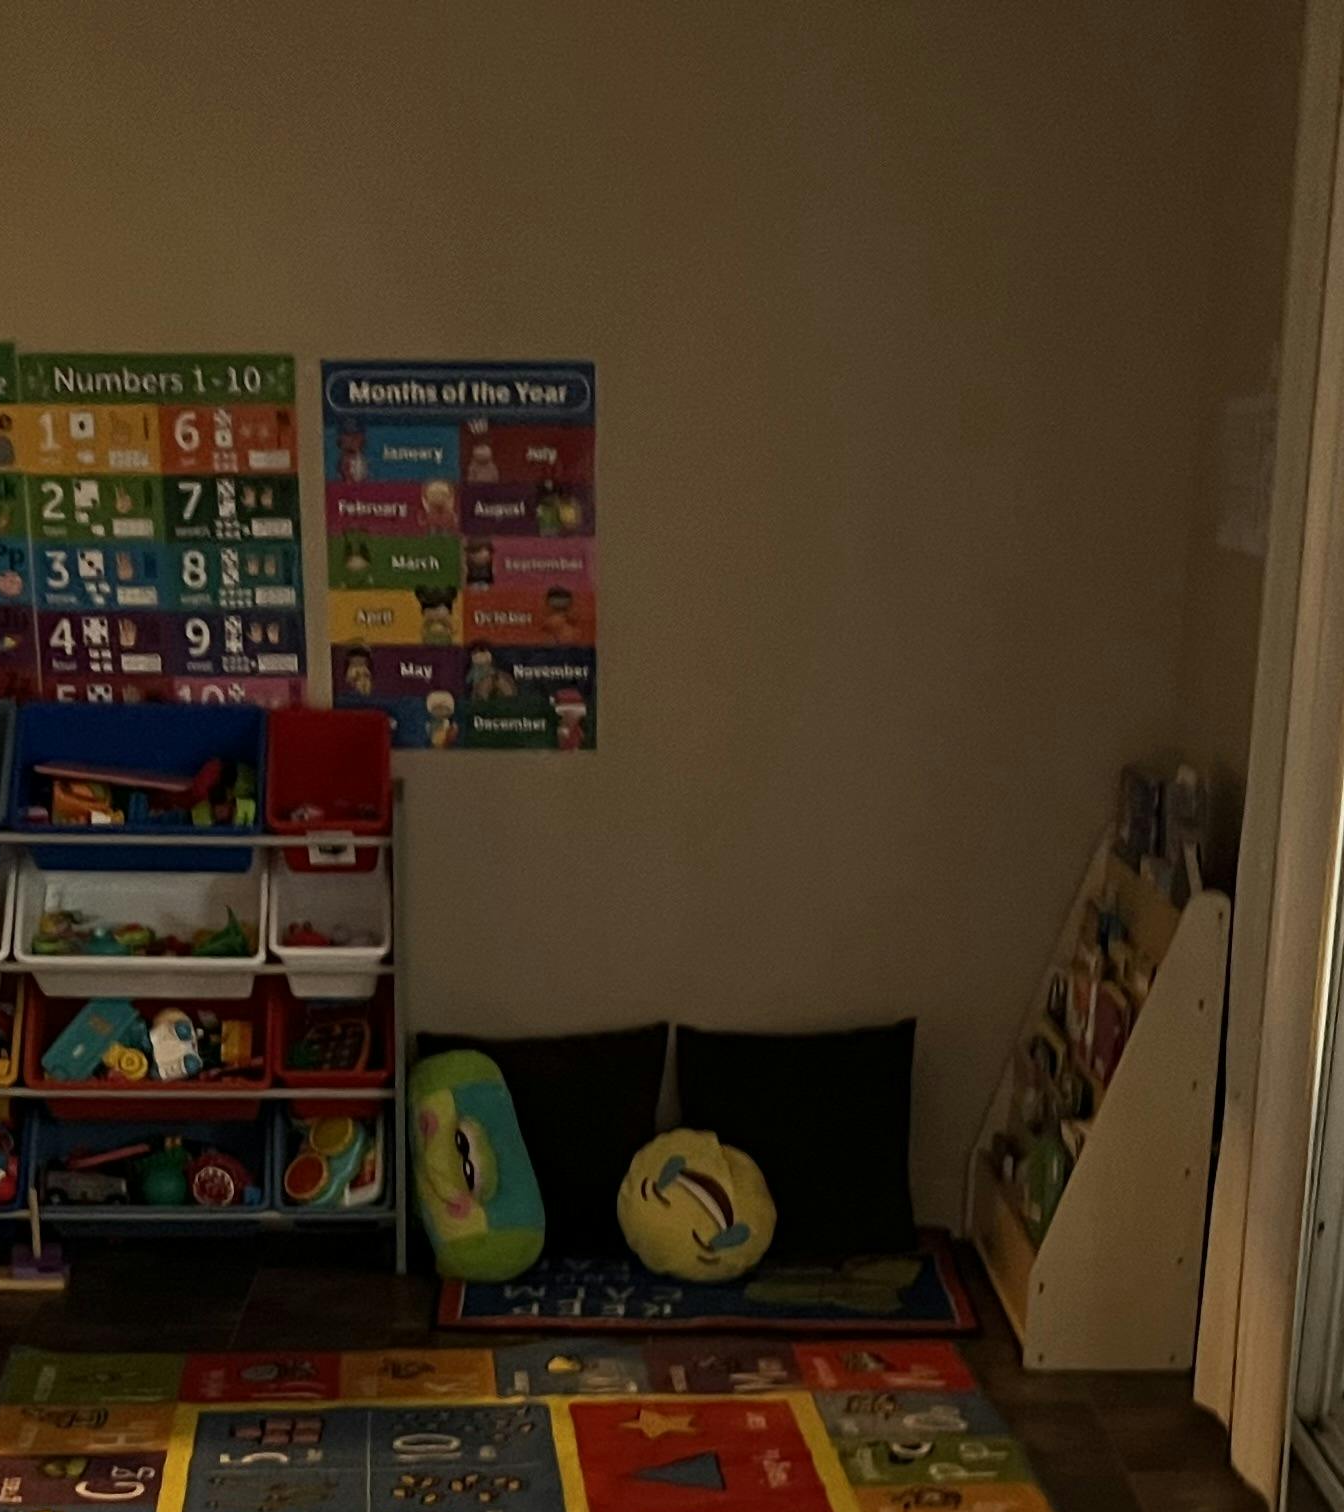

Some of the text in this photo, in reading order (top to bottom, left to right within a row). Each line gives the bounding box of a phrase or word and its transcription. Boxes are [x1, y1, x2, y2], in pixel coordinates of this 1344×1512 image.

[53, 365, 184, 394] Numbers
[347, 380, 568, 406] Months of the Year
[39, 412, 62, 452] 1
[173, 410, 200, 452] 6
[382, 443, 444, 465] January
[40, 481, 67, 521] 2
[177, 481, 202, 521] 7
[44, 550, 70, 590] 3
[182, 549, 208, 591] 8
[47, 617, 77, 656] 4
[185, 617, 212, 657] 9
[399, 659, 433, 683] May
[74, 1465, 156, 1500] Gg
